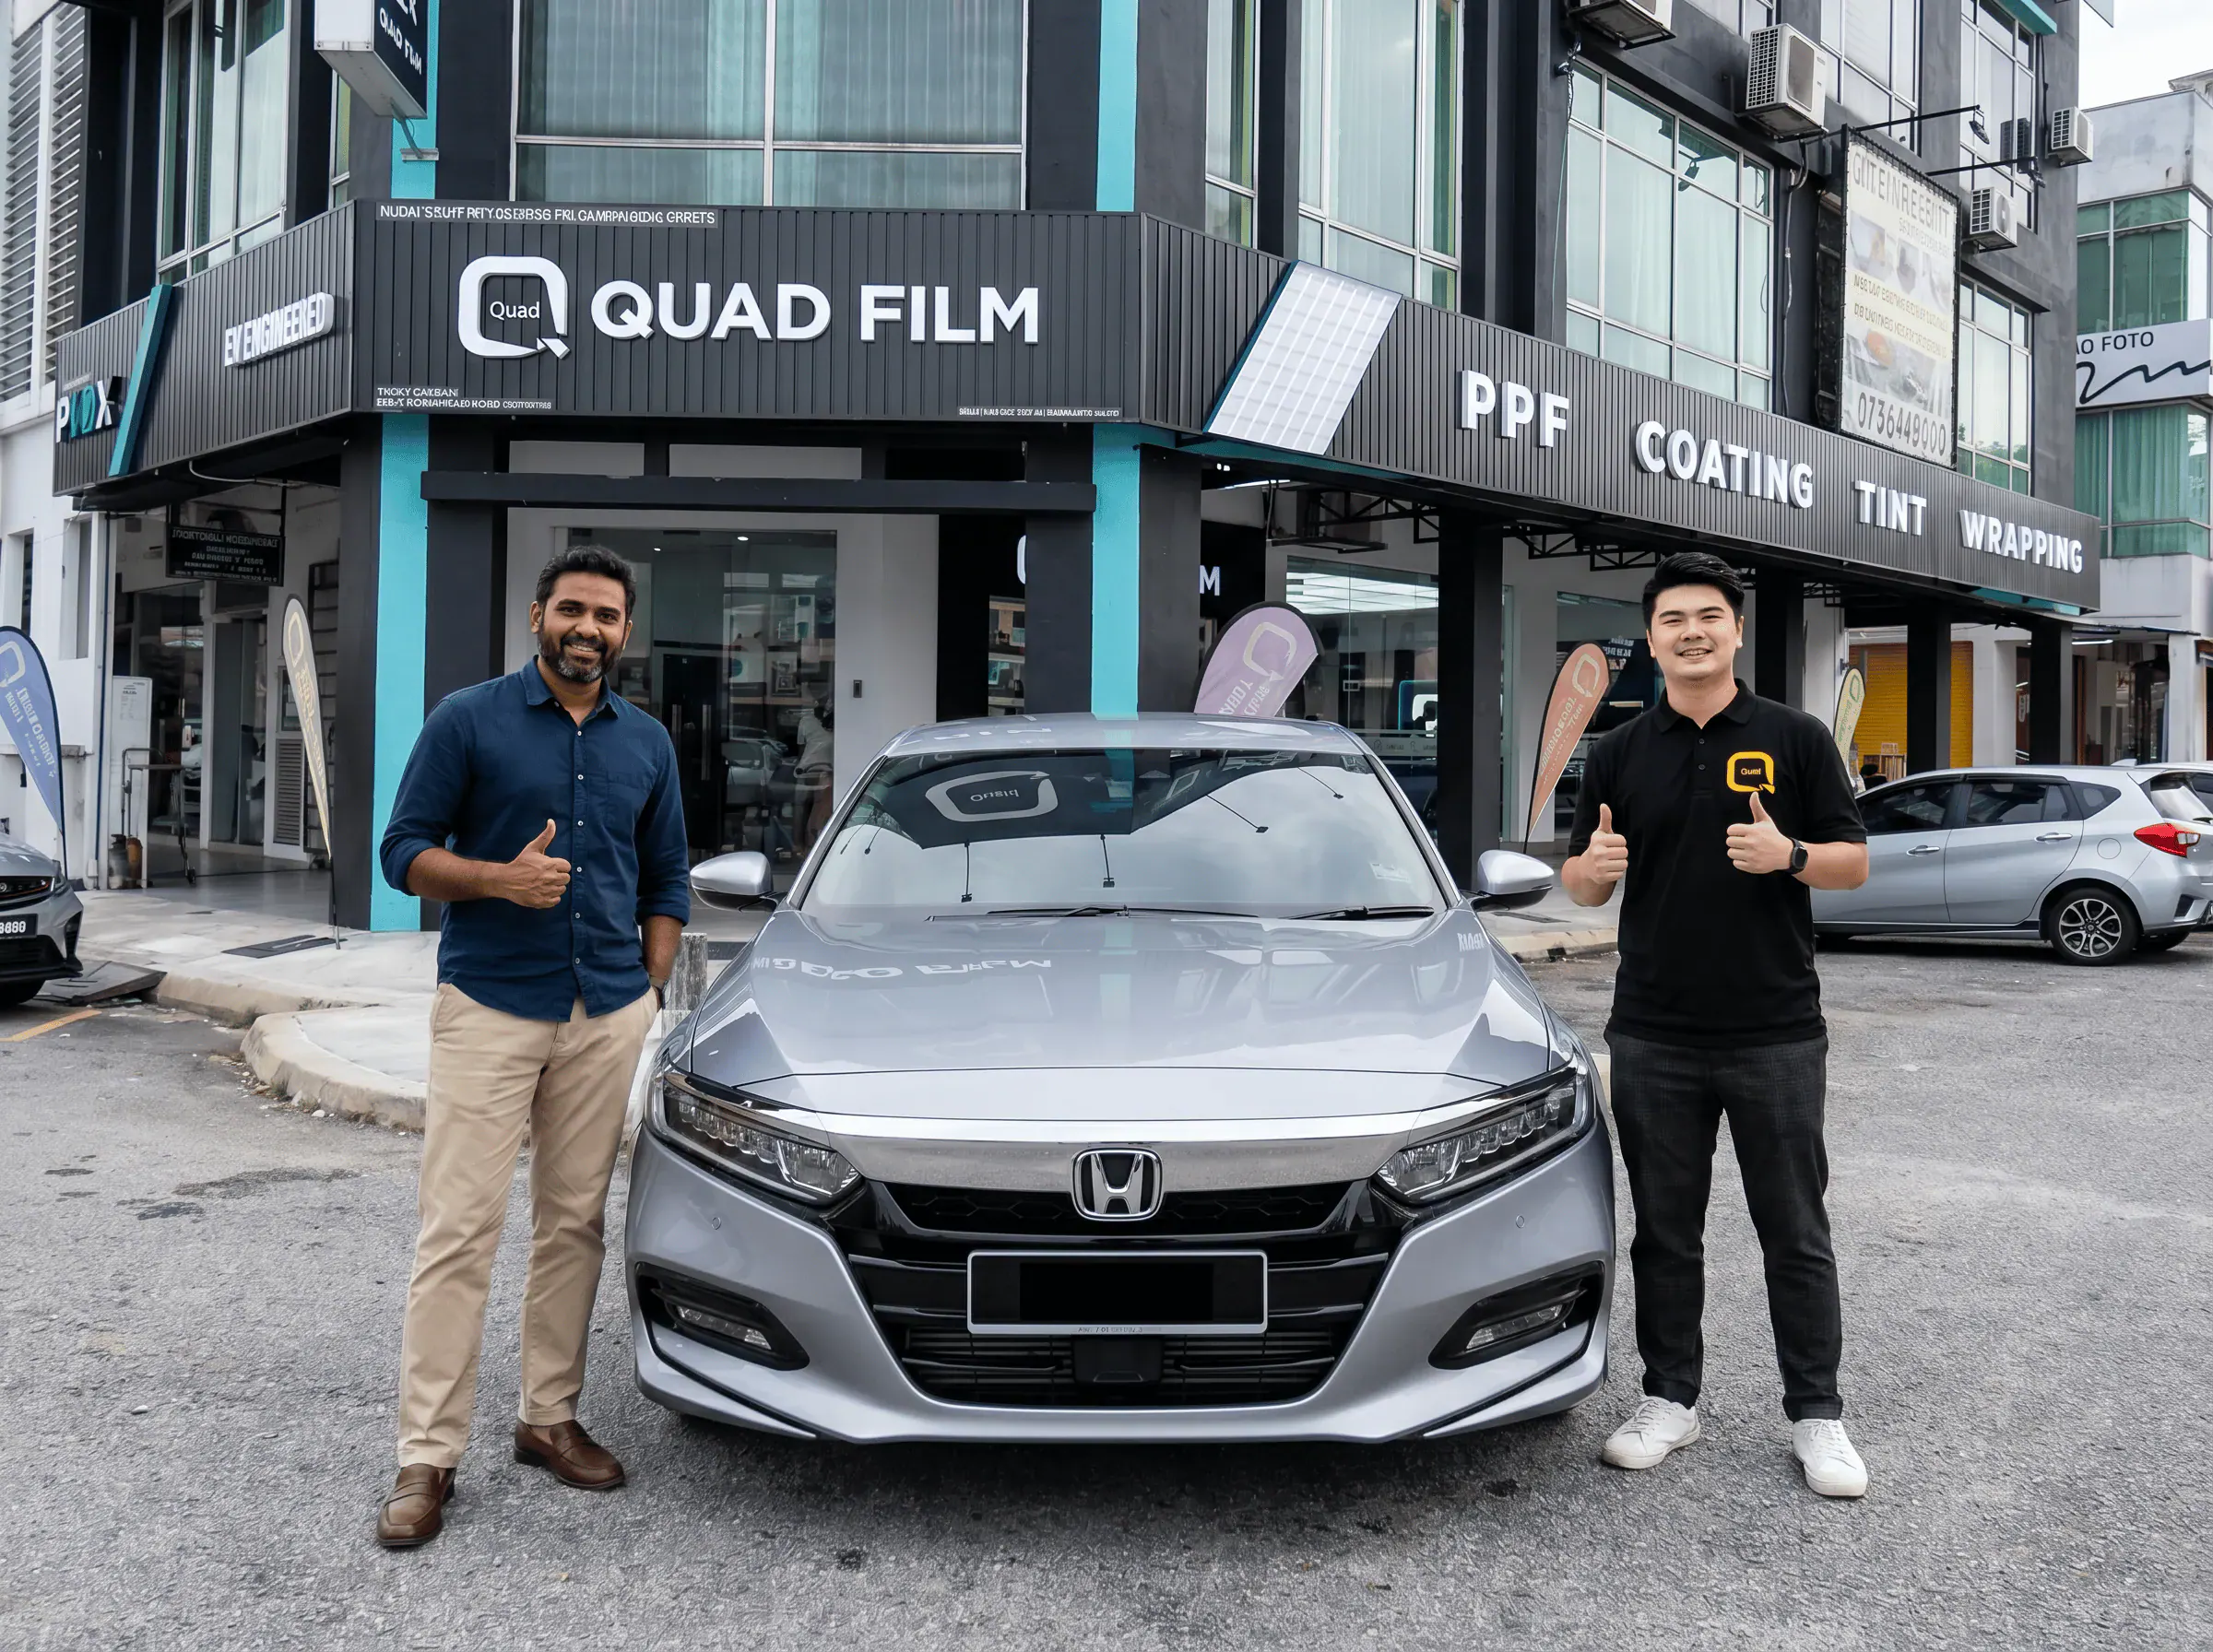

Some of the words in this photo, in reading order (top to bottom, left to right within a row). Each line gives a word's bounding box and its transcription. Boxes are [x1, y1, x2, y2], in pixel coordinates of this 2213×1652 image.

[490, 301, 540, 321] Quad
[590, 279, 831, 340] QUAD
[859, 284, 1039, 344] FILM
[2101, 330, 2154, 352] FOTO
[1461, 369, 1570, 448] PPF
[1635, 420, 1814, 509] COATING
[1854, 479, 1928, 537] TINT
[1959, 509, 2083, 574] WRAPPING
[1199, 564, 1221, 596] M
